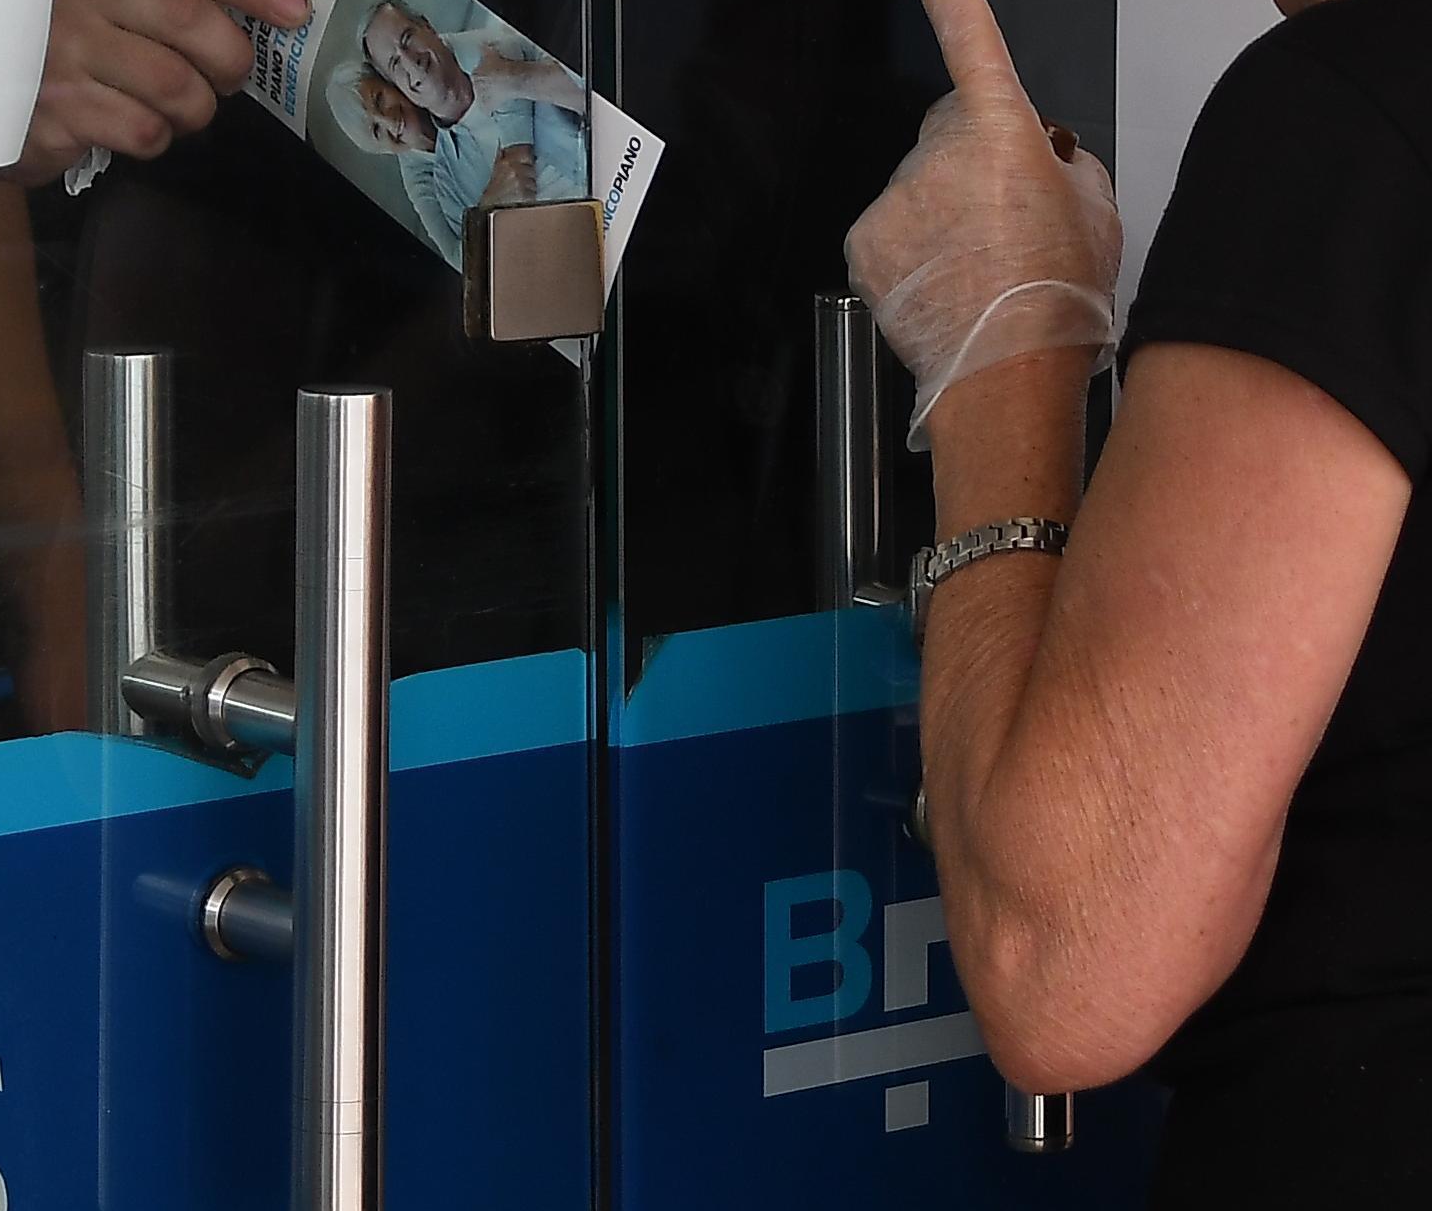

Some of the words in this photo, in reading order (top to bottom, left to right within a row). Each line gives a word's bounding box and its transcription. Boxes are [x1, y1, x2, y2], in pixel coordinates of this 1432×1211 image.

[255, 20, 272, 93] HABERE
[270, 50, 284, 105] PIANO
[603, 136, 642, 233] NCOPIANO
